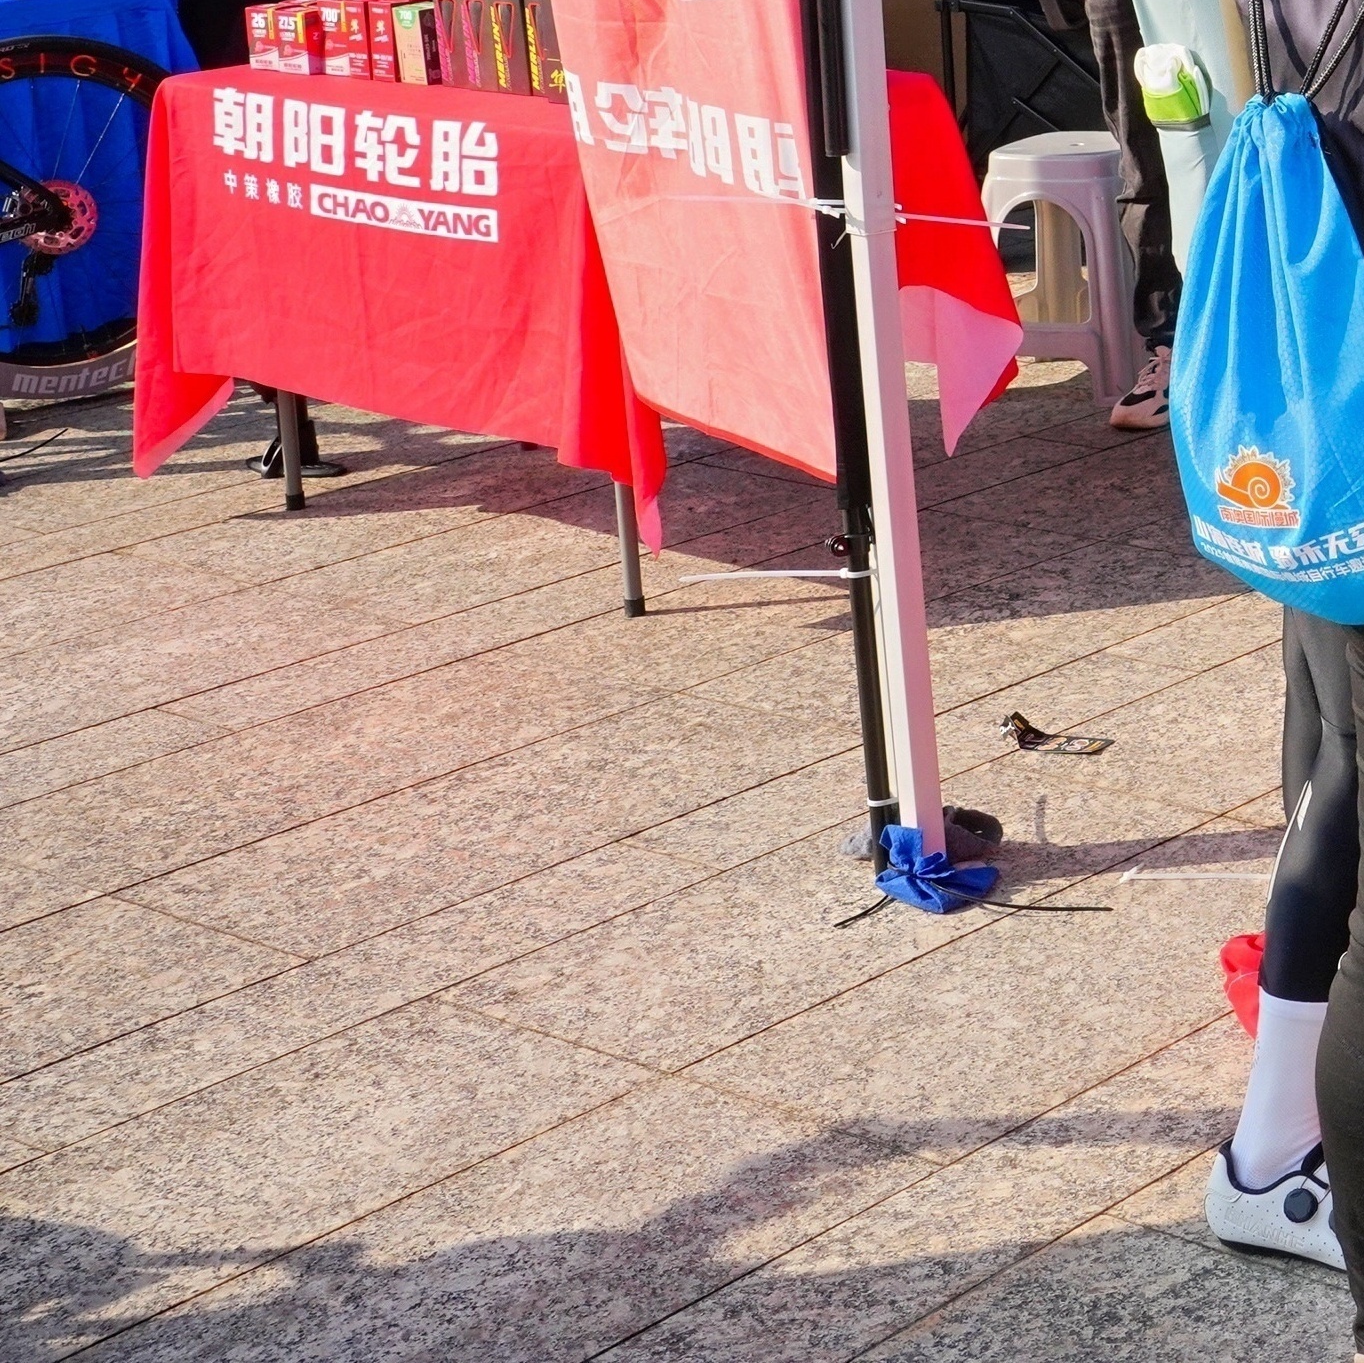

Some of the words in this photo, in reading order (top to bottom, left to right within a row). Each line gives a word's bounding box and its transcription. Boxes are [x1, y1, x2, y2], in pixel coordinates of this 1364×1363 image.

[213, 87, 499, 197] 朝阳轮胎
[223, 169, 304, 210] 中策橡胶
